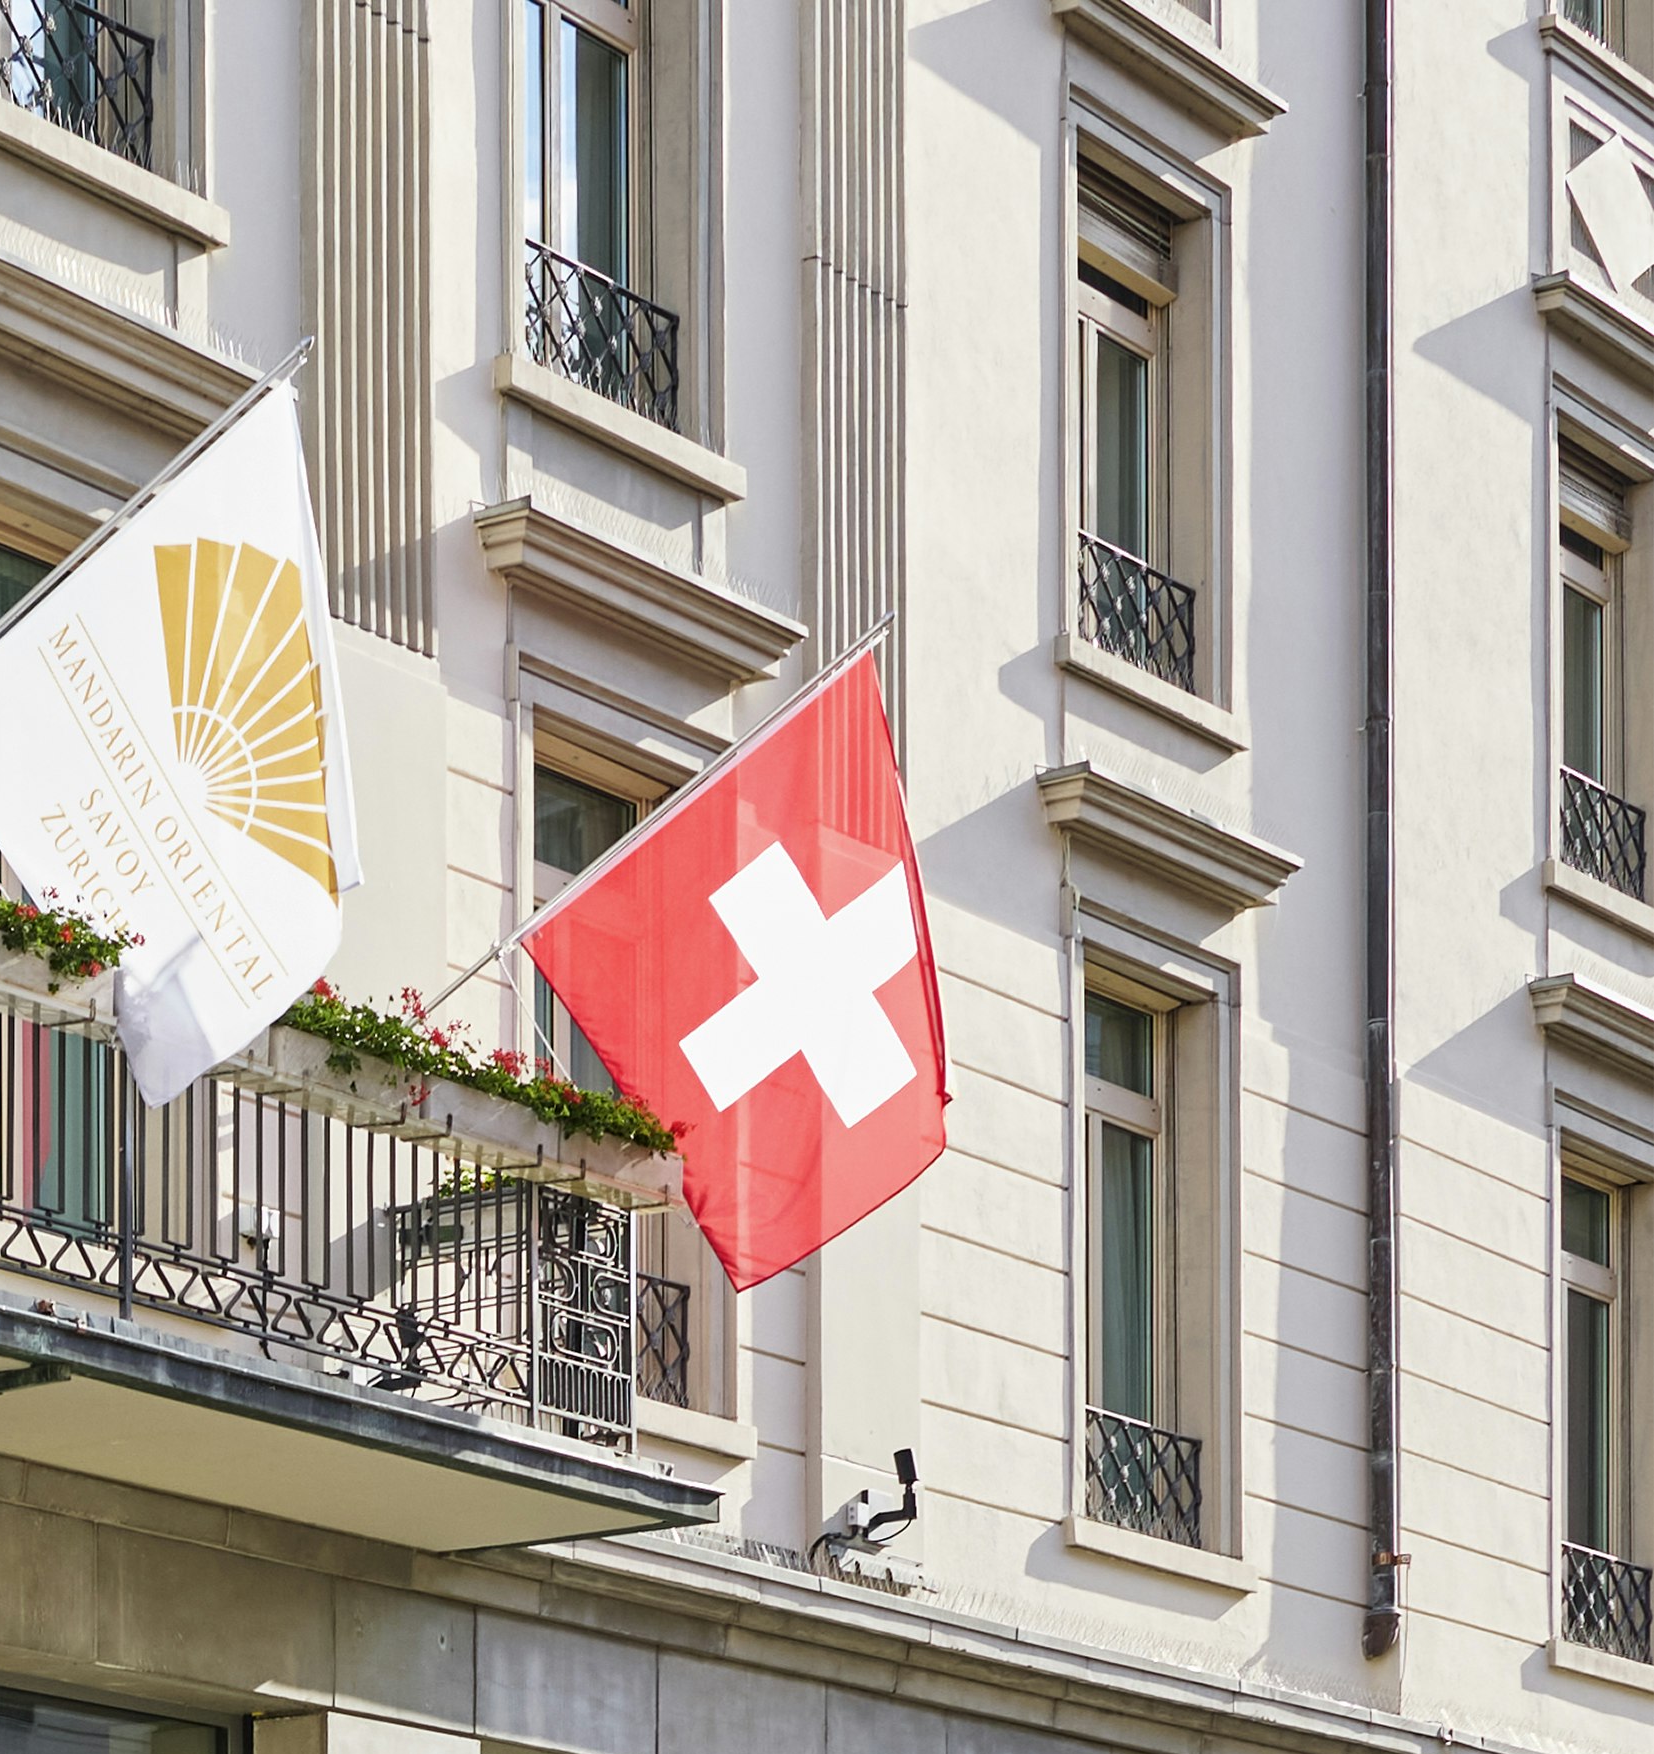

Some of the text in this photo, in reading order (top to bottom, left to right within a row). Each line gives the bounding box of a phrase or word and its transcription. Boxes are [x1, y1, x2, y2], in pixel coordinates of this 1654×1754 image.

[40, 803, 130, 933] ZURICH
[48, 623, 277, 1000] MANDARIN ORIENTAL
[80, 787, 155, 896] SAVOY
